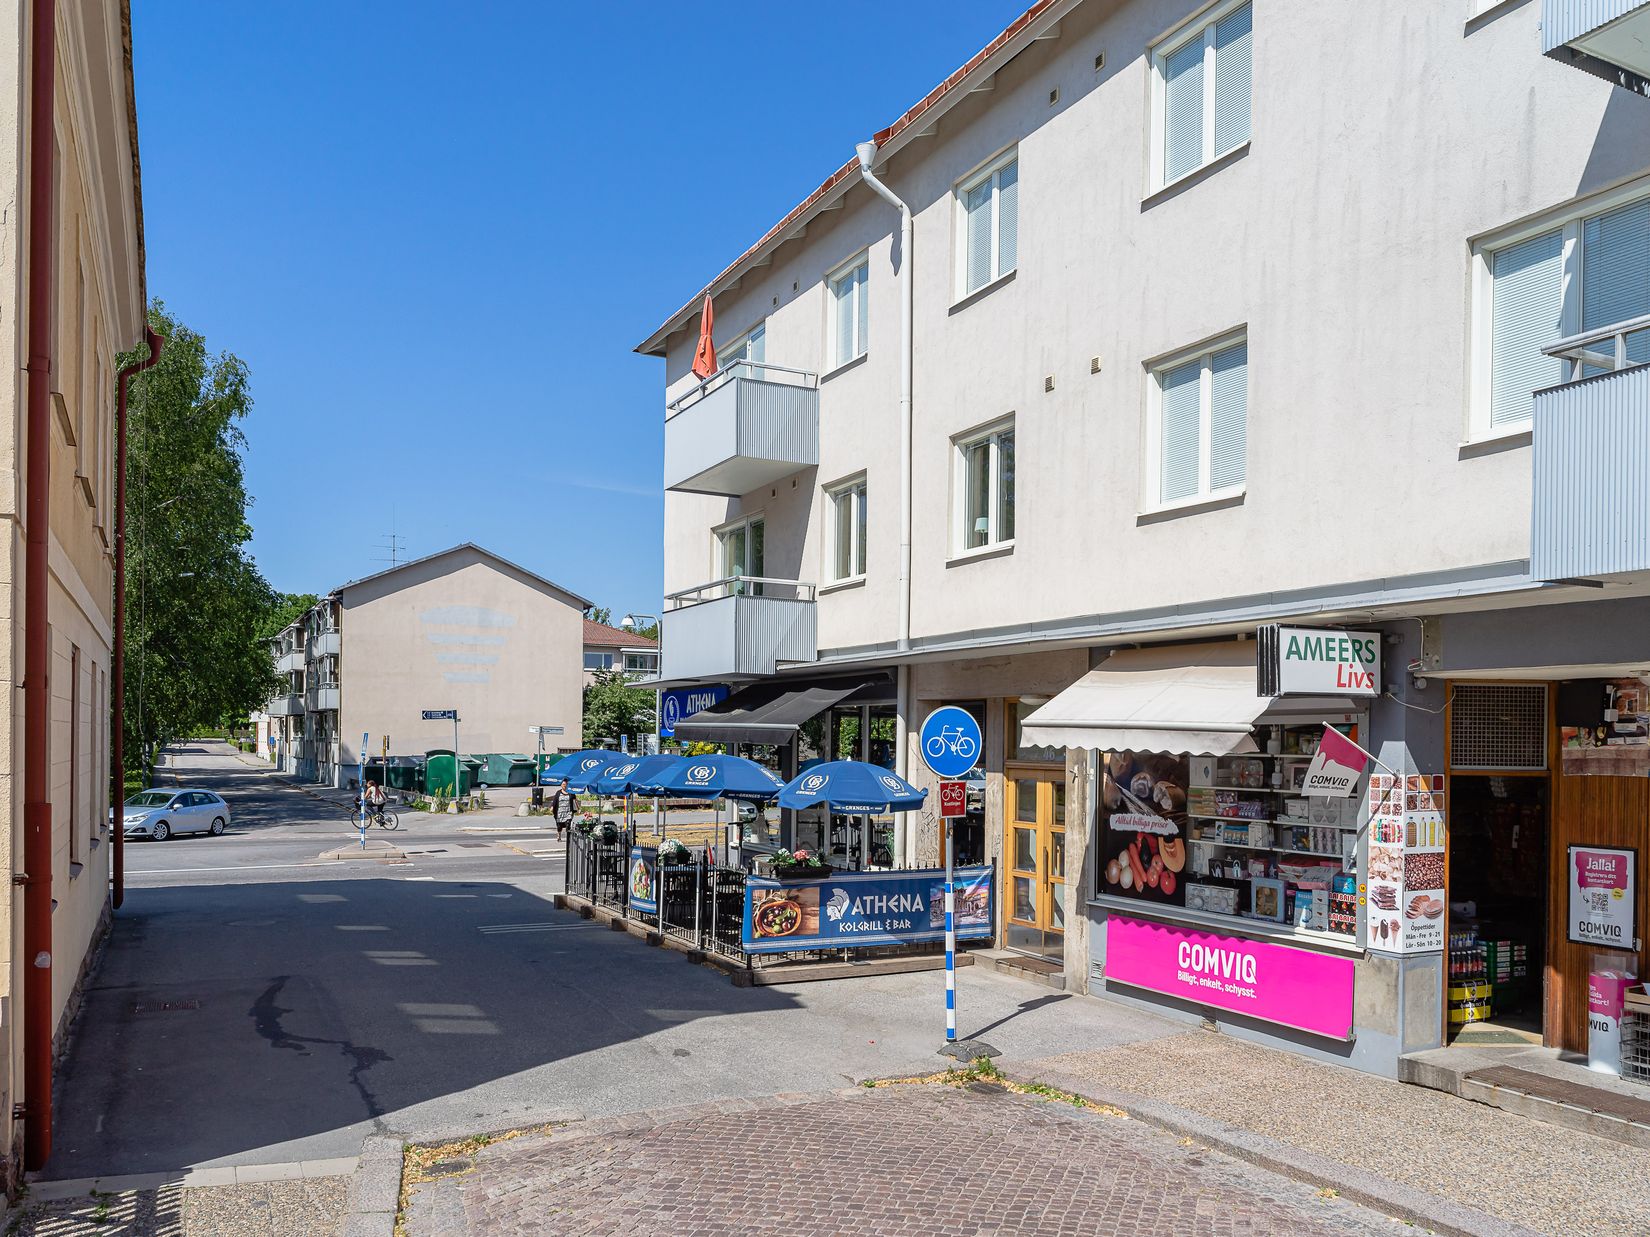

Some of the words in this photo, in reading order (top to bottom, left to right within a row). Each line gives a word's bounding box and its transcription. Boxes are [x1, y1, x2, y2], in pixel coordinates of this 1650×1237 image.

[1286, 635, 1376, 663] AMEERS
[1337, 663, 1375, 689] Livs
[686, 693, 716, 713] ATHENA
[1310, 775, 1349, 786] COMVIQ
[1115, 816, 1131, 825] Alltid
[1133, 816, 1150, 829] billiga
[1586, 857, 1615, 871] Jalla!
[851, 893, 925, 916] ATHENA
[839, 920, 883, 933] KOLGRILL
[893, 919, 911, 930] BAR
[1411, 922, 1435, 931] Öppettider
[1579, 921, 1622, 938] COMVIQ
[1178, 941, 1257, 984] COMVIQ
[1177, 970, 1199, 986] Billigt,
[1199, 977, 1224, 992] enkelt,
[1225, 983, 1257, 998] schysst.
